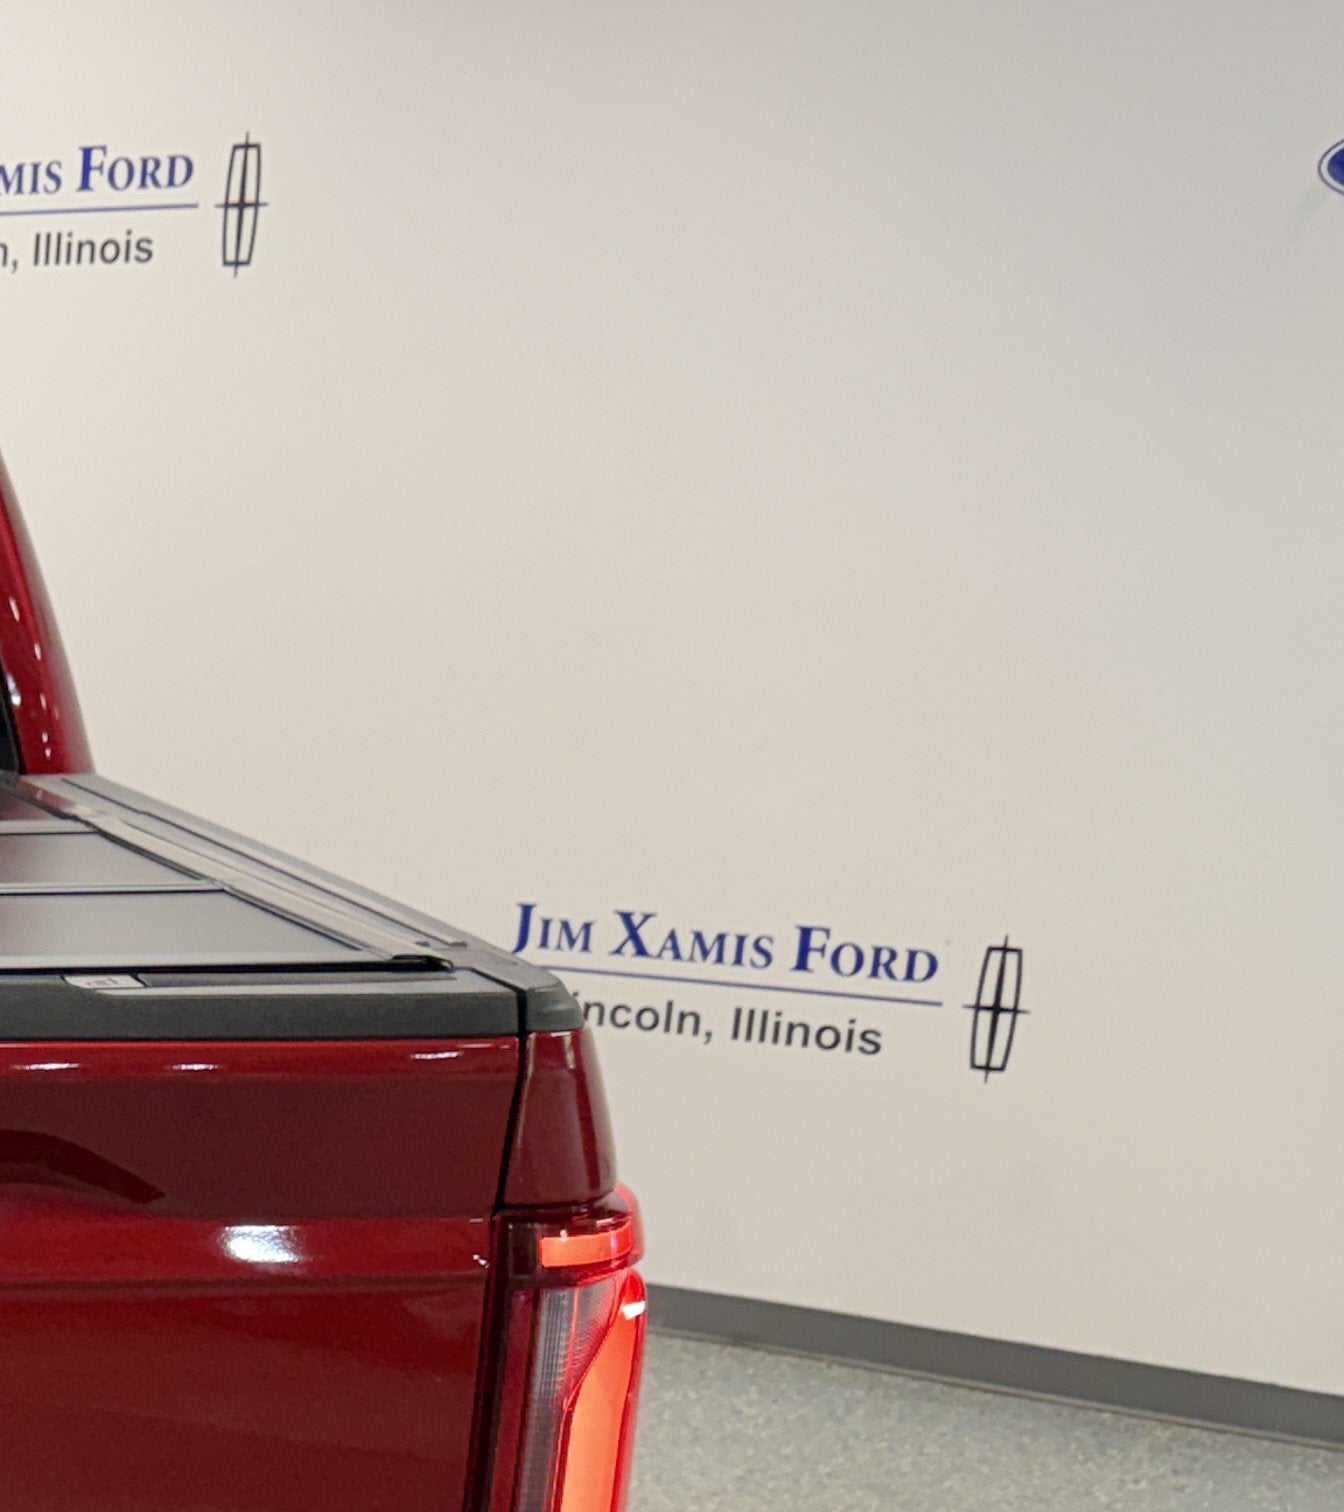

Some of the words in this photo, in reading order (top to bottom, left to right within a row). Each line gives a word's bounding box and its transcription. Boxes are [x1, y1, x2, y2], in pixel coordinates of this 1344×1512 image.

[76, 143, 195, 194] FORD
[32, 229, 155, 268] Illinois
[512, 902, 597, 955] JIM
[608, 909, 774, 970] XAMIS
[789, 924, 939, 983] FORD
[573, 990, 714, 1044] ncoln,
[730, 1006, 883, 1057] Illinois
